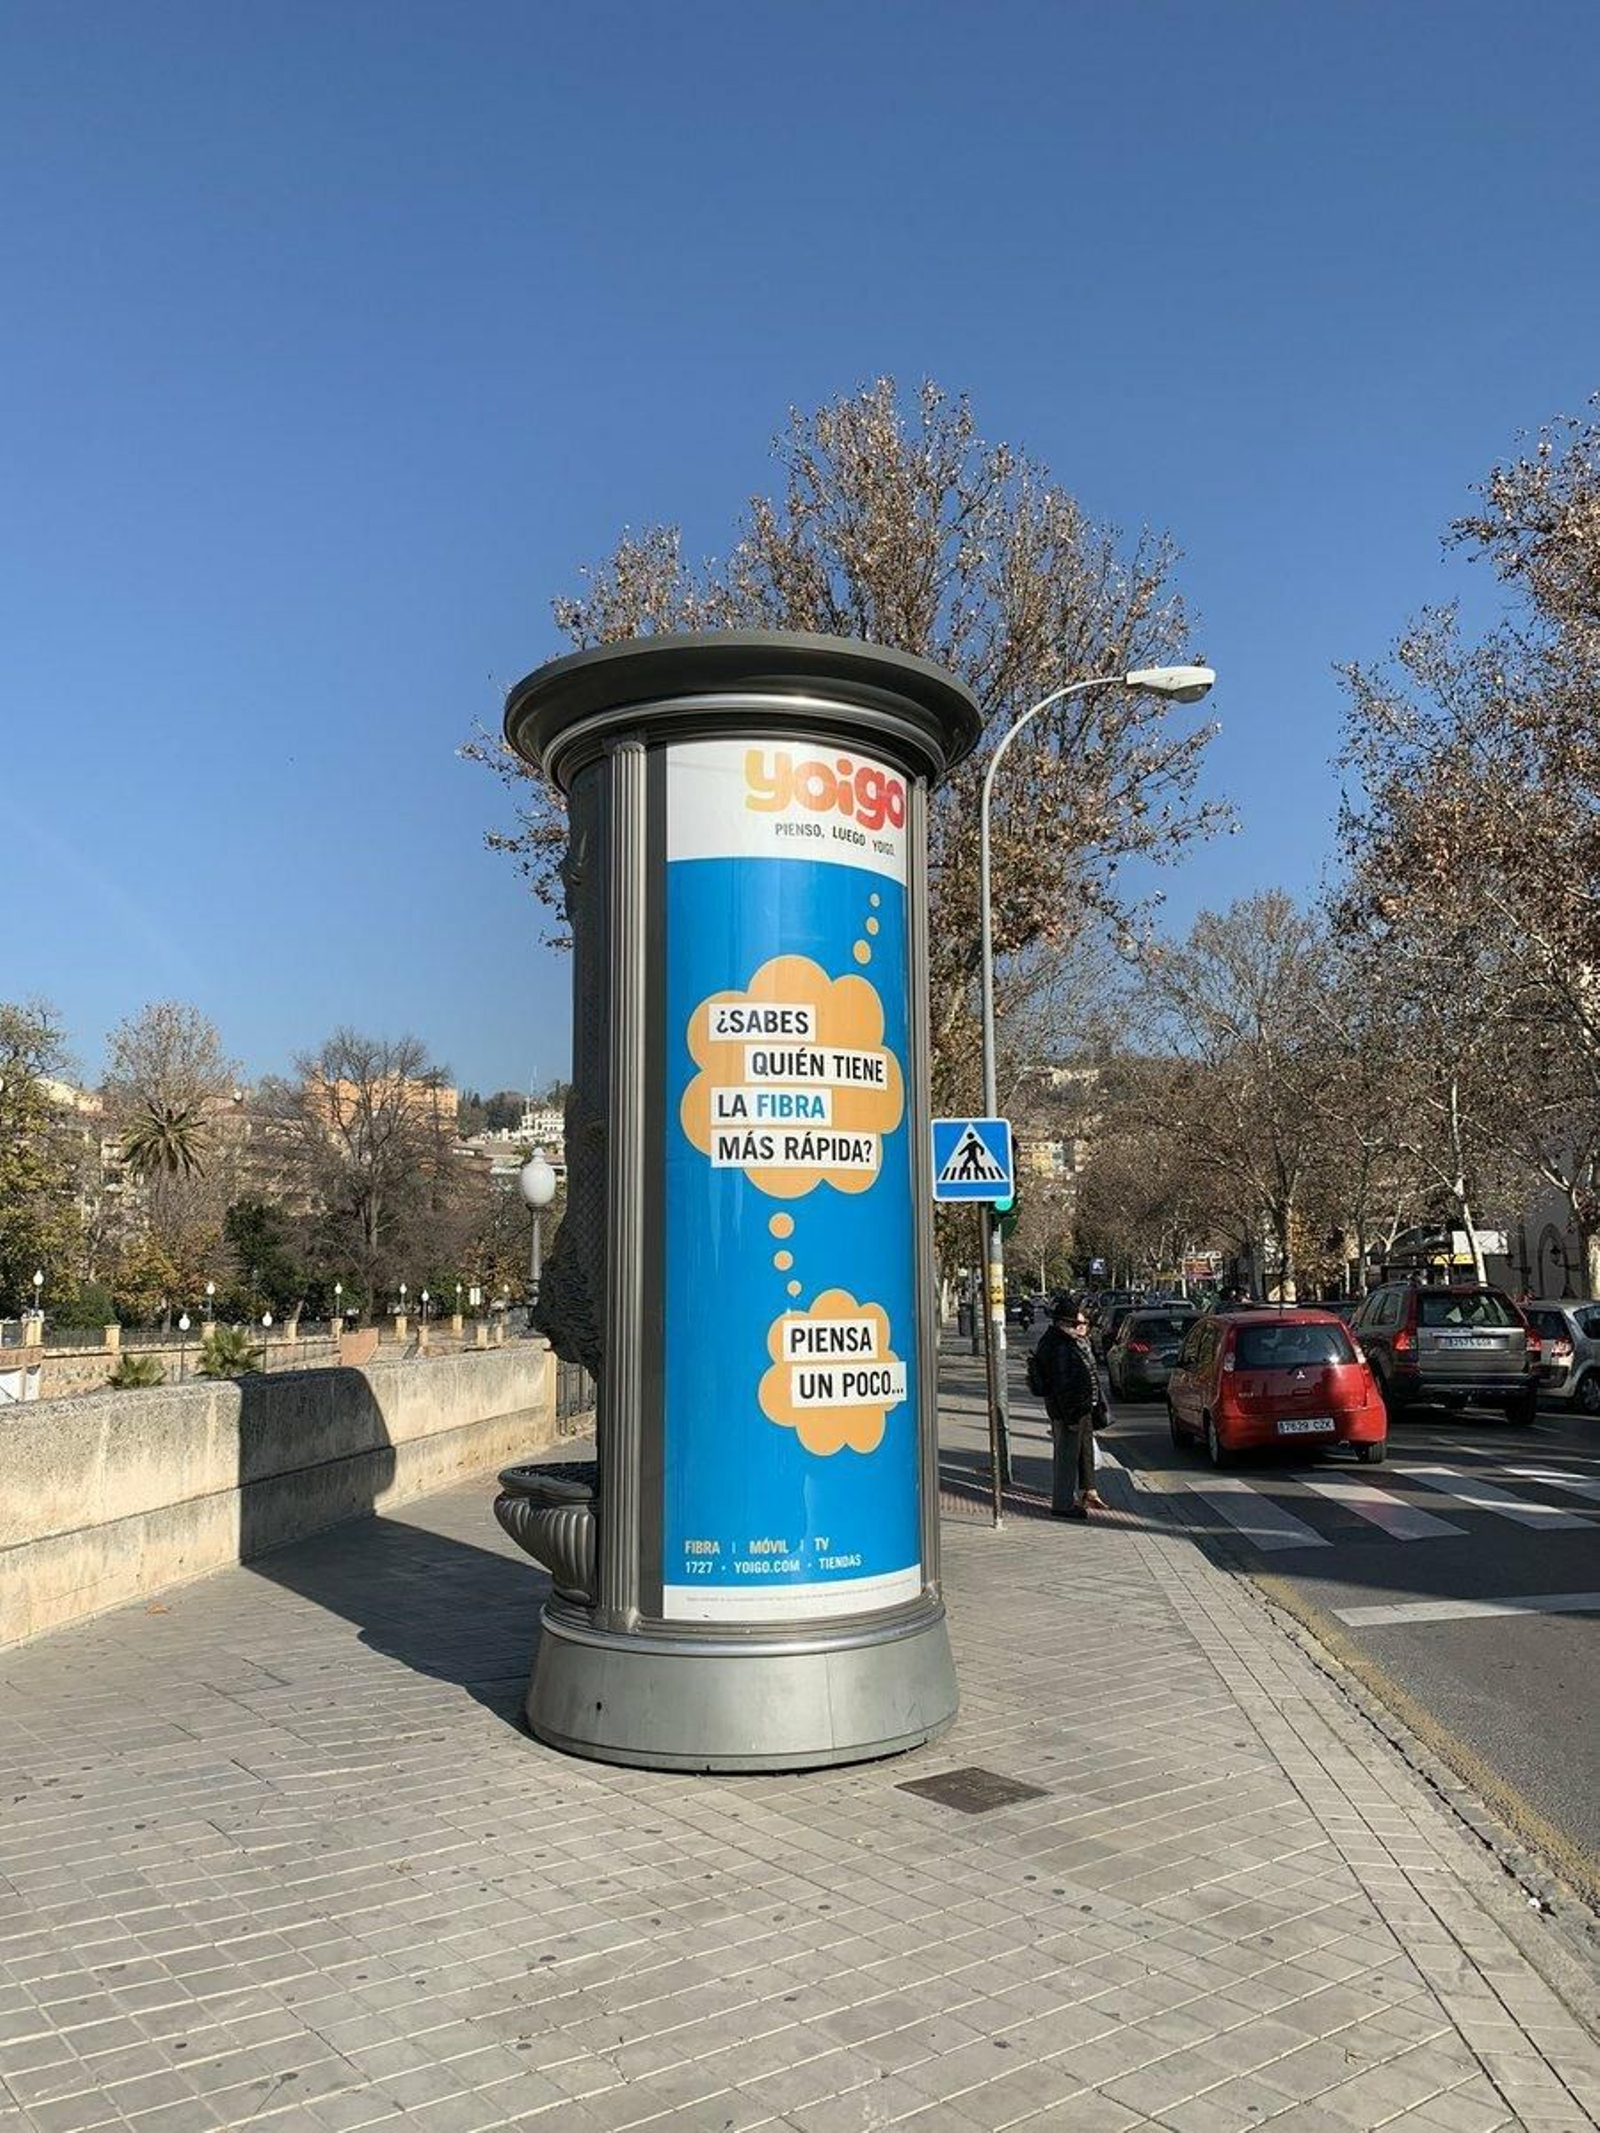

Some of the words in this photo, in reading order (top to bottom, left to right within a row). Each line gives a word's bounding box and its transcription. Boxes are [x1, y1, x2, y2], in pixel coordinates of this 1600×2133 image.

[745, 750, 905, 830] yoigo
[832, 826, 866, 846] LUEGO
[716, 1010, 809, 1034] ¿SABES
[752, 1047, 825, 1077] QUIÉN
[833, 1055, 884, 1083] TIENE
[718, 1094, 748, 1118] LA
[757, 1094, 825, 1119] FIBRA
[718, 1131, 774, 1160] MÁS
[785, 1131, 872, 1163] RÁPIDA?
[791, 1327, 872, 1353] PIENSA
[799, 1373, 833, 1399] UN
[842, 1370, 904, 1397] POCO...
[684, 1540, 720, 1555] FIBRA
[749, 1537, 789, 1554] MÓVIL
[813, 1537, 830, 1551] TV
[685, 1561, 712, 1574] 1727
[734, 1560, 800, 1574] YOIGO.COM
[819, 1554, 862, 1570] TIENDAS
